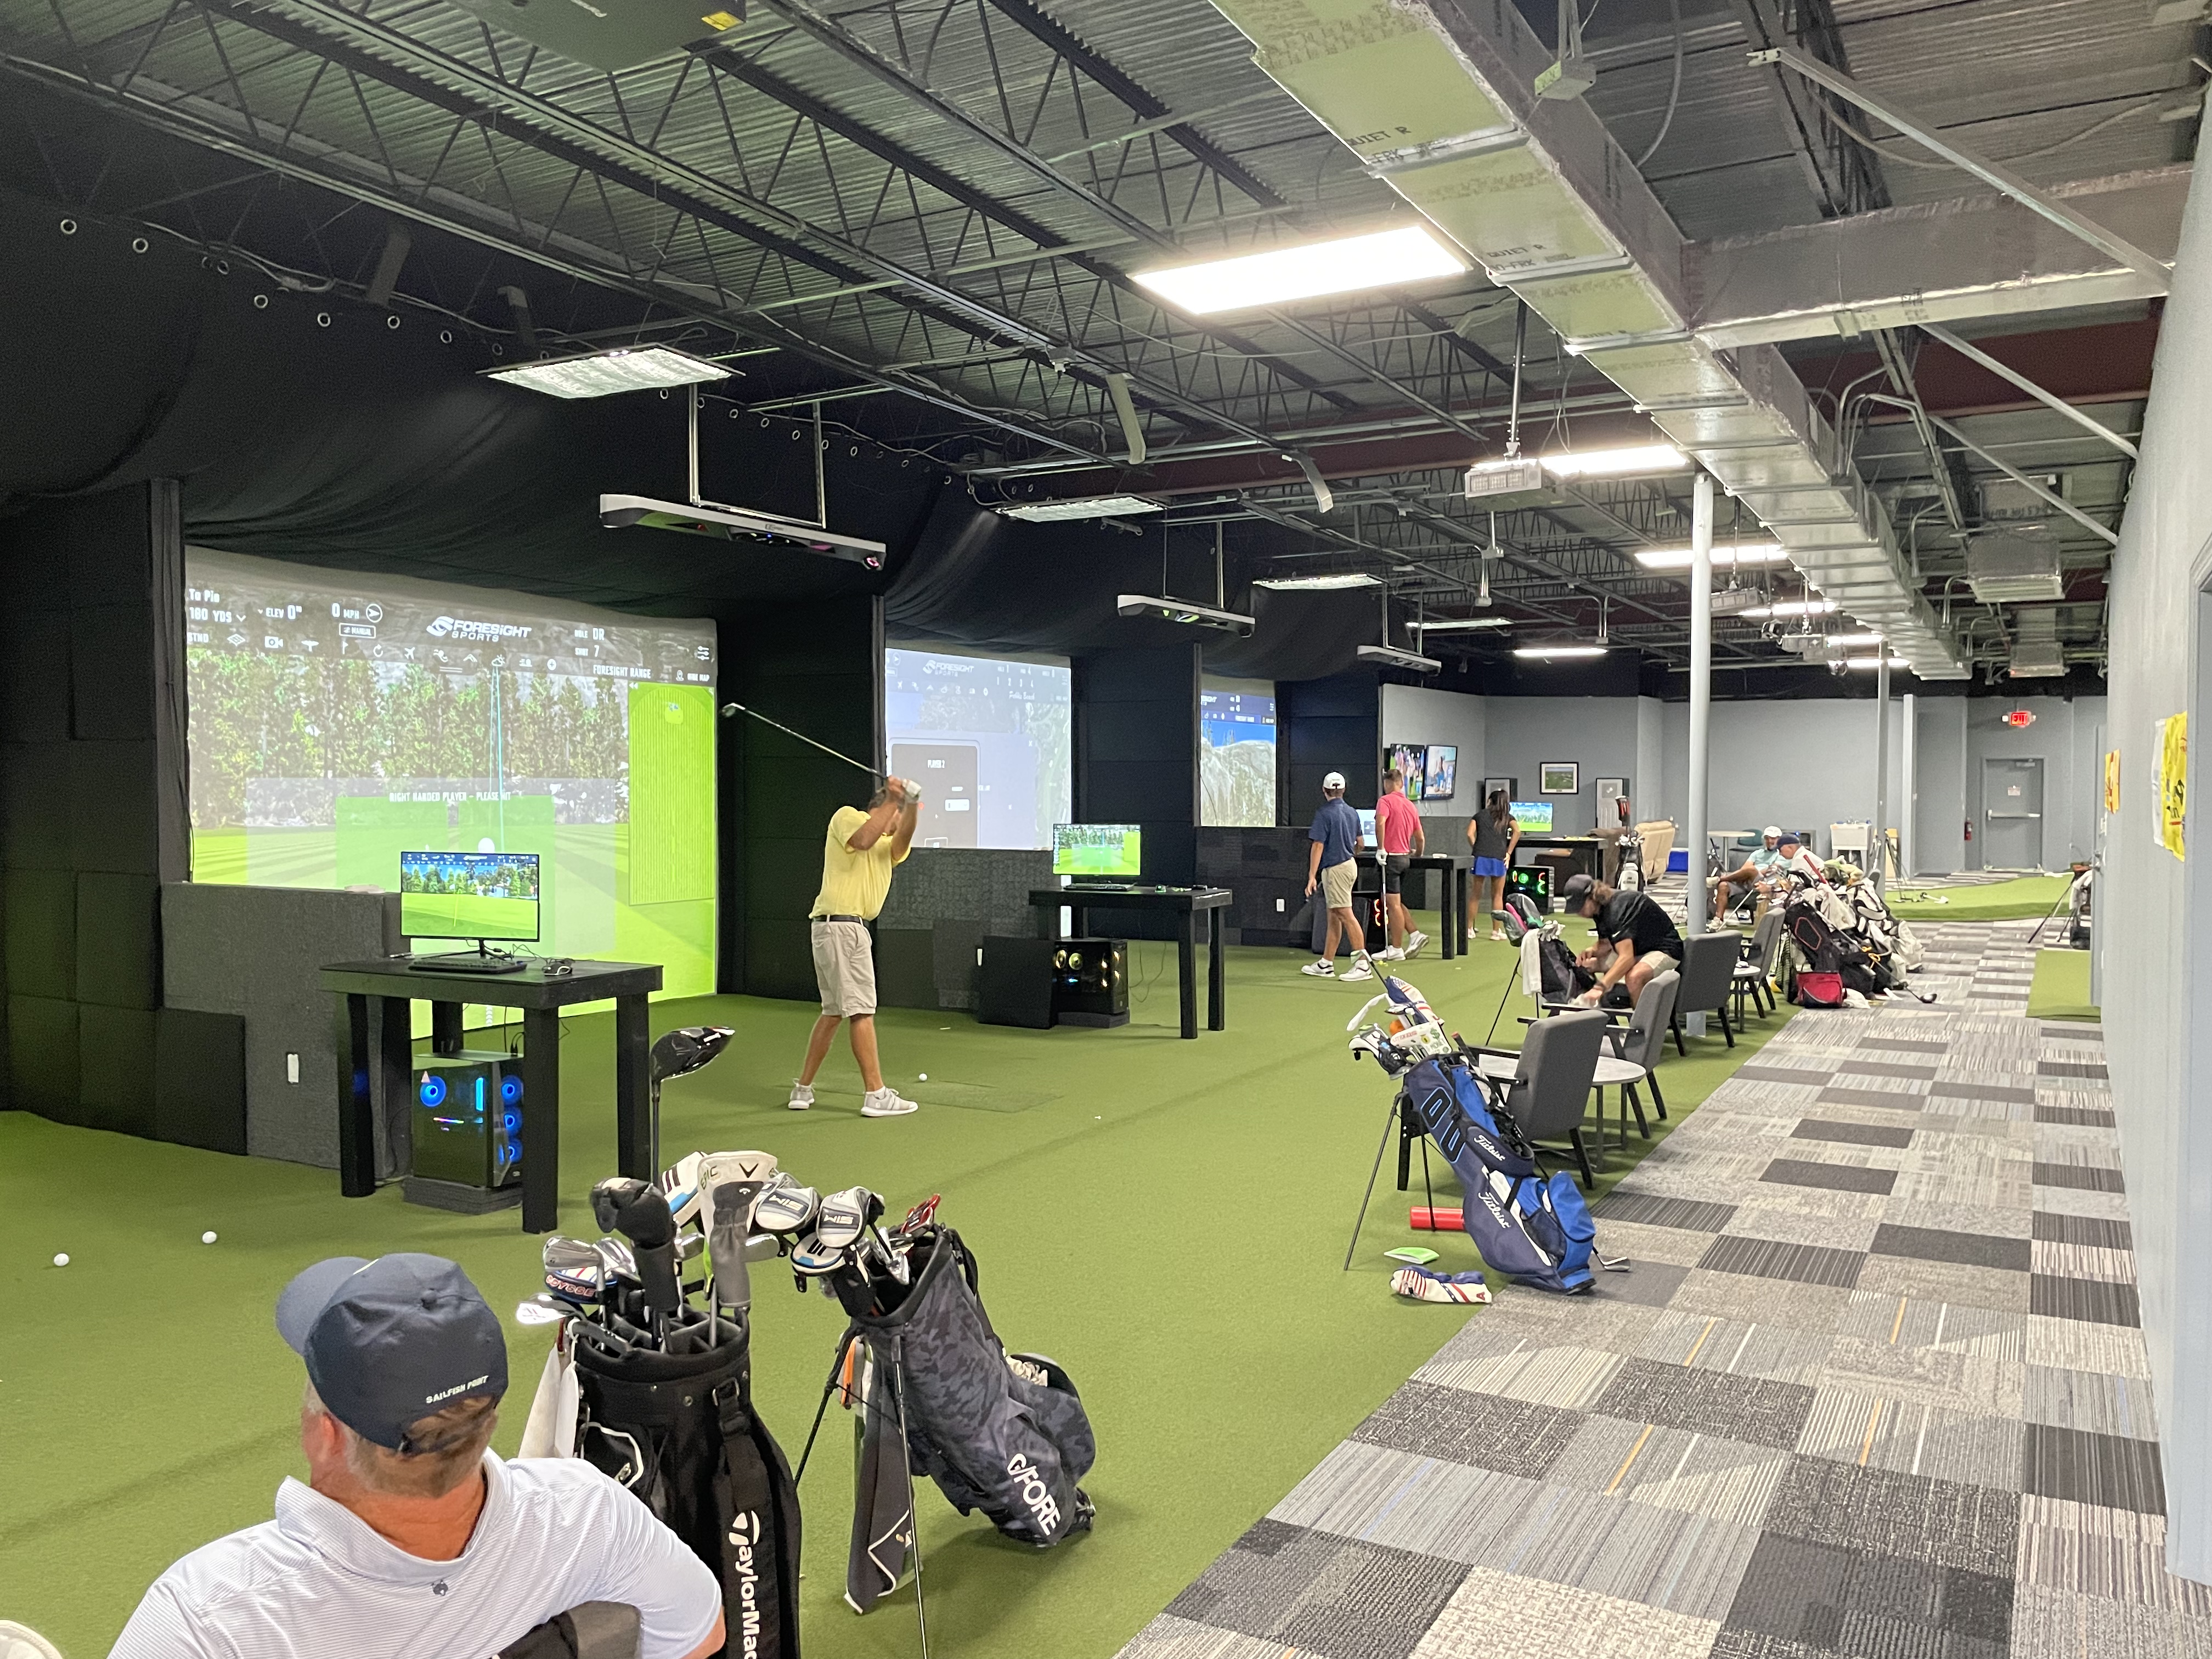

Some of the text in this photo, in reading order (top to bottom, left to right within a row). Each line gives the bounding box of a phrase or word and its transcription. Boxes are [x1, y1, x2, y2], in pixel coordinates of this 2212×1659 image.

[189, 588, 220, 602] To Pin
[212, 610, 232, 623] YDS
[266, 607, 284, 618] ELEV
[343, 609, 360, 619] MPH
[188, 632, 208, 643] STND
[452, 631, 499, 642] SPORTS
[594, 645, 600, 657] 7
[593, 664, 651, 679] FORESIGHT RANGE
[390, 792, 410, 802] RIGHT
[442, 792, 467, 802] PLAYER
[476, 792, 499, 801] PLEASE
[1474, 1135, 1505, 1161] Titleist
[700, 1165, 719, 1190] EPIC
[1478, 1191, 1511, 1228] Titleist
[425, 1375, 489, 1404] SAILFISH POINT
[1007, 1453, 1061, 1536] G/FORE
